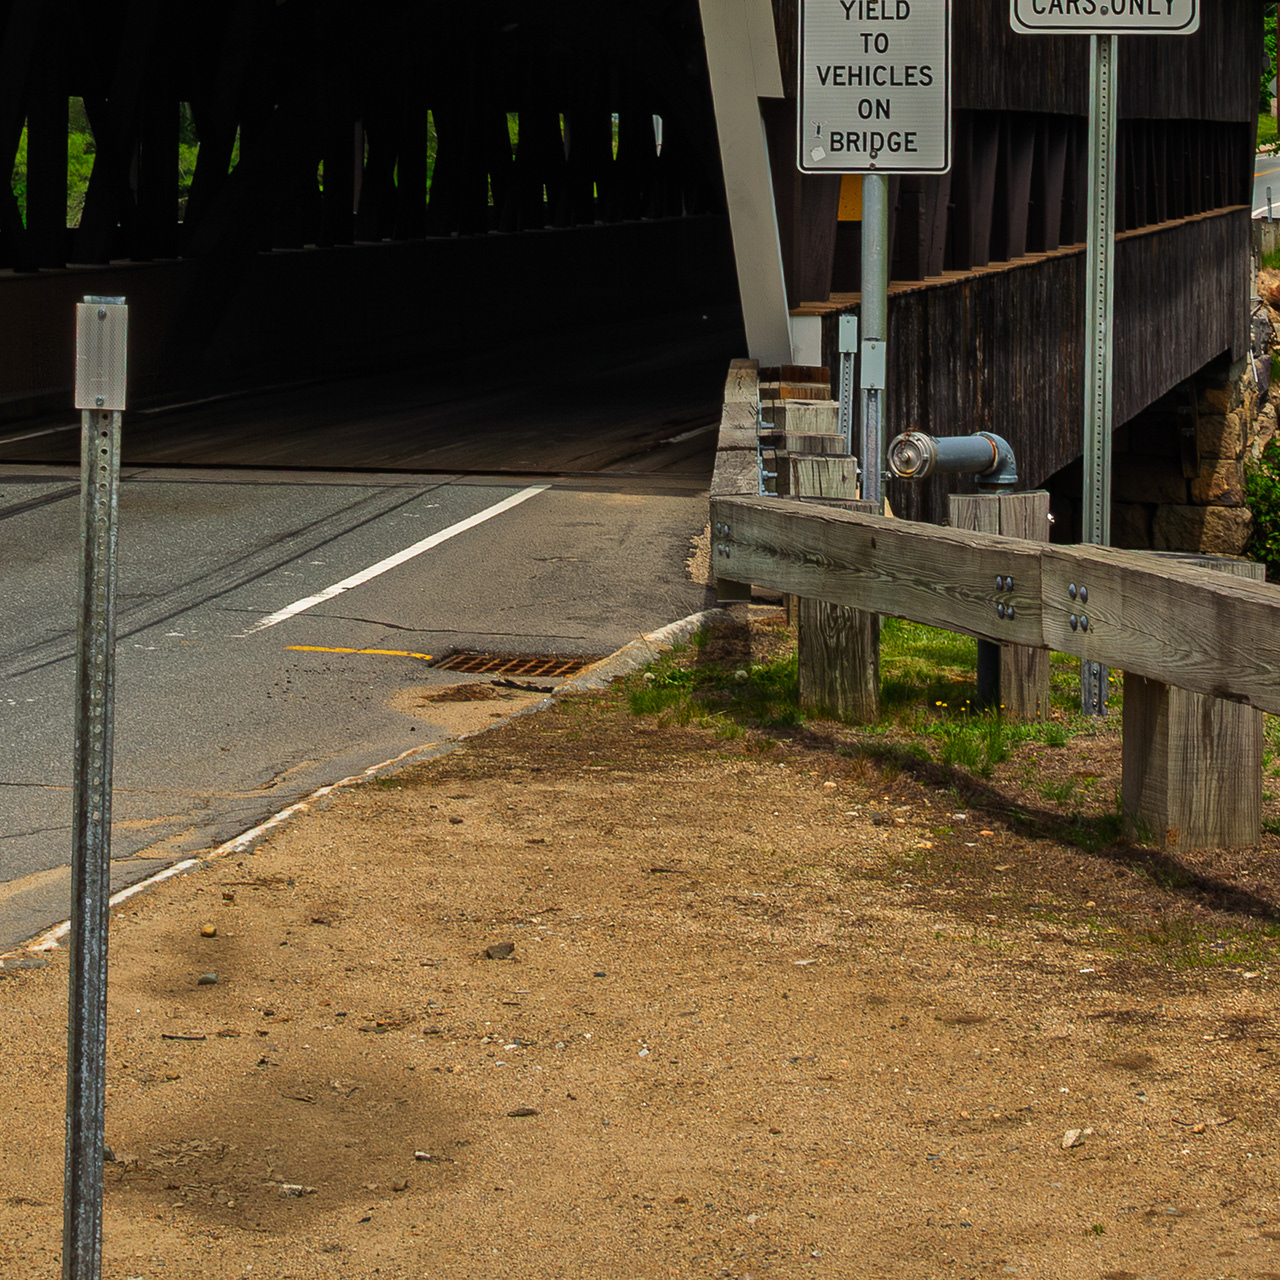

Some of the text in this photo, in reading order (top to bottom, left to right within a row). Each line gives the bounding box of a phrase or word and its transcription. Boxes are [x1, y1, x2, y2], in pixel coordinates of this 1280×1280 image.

[840, 0, 911, 21] YIELD
[860, 32, 889, 54] TO
[816, 65, 933, 87] VEHICLES
[858, 98, 891, 120] ON
[830, 131, 918, 153] BRIDGE
